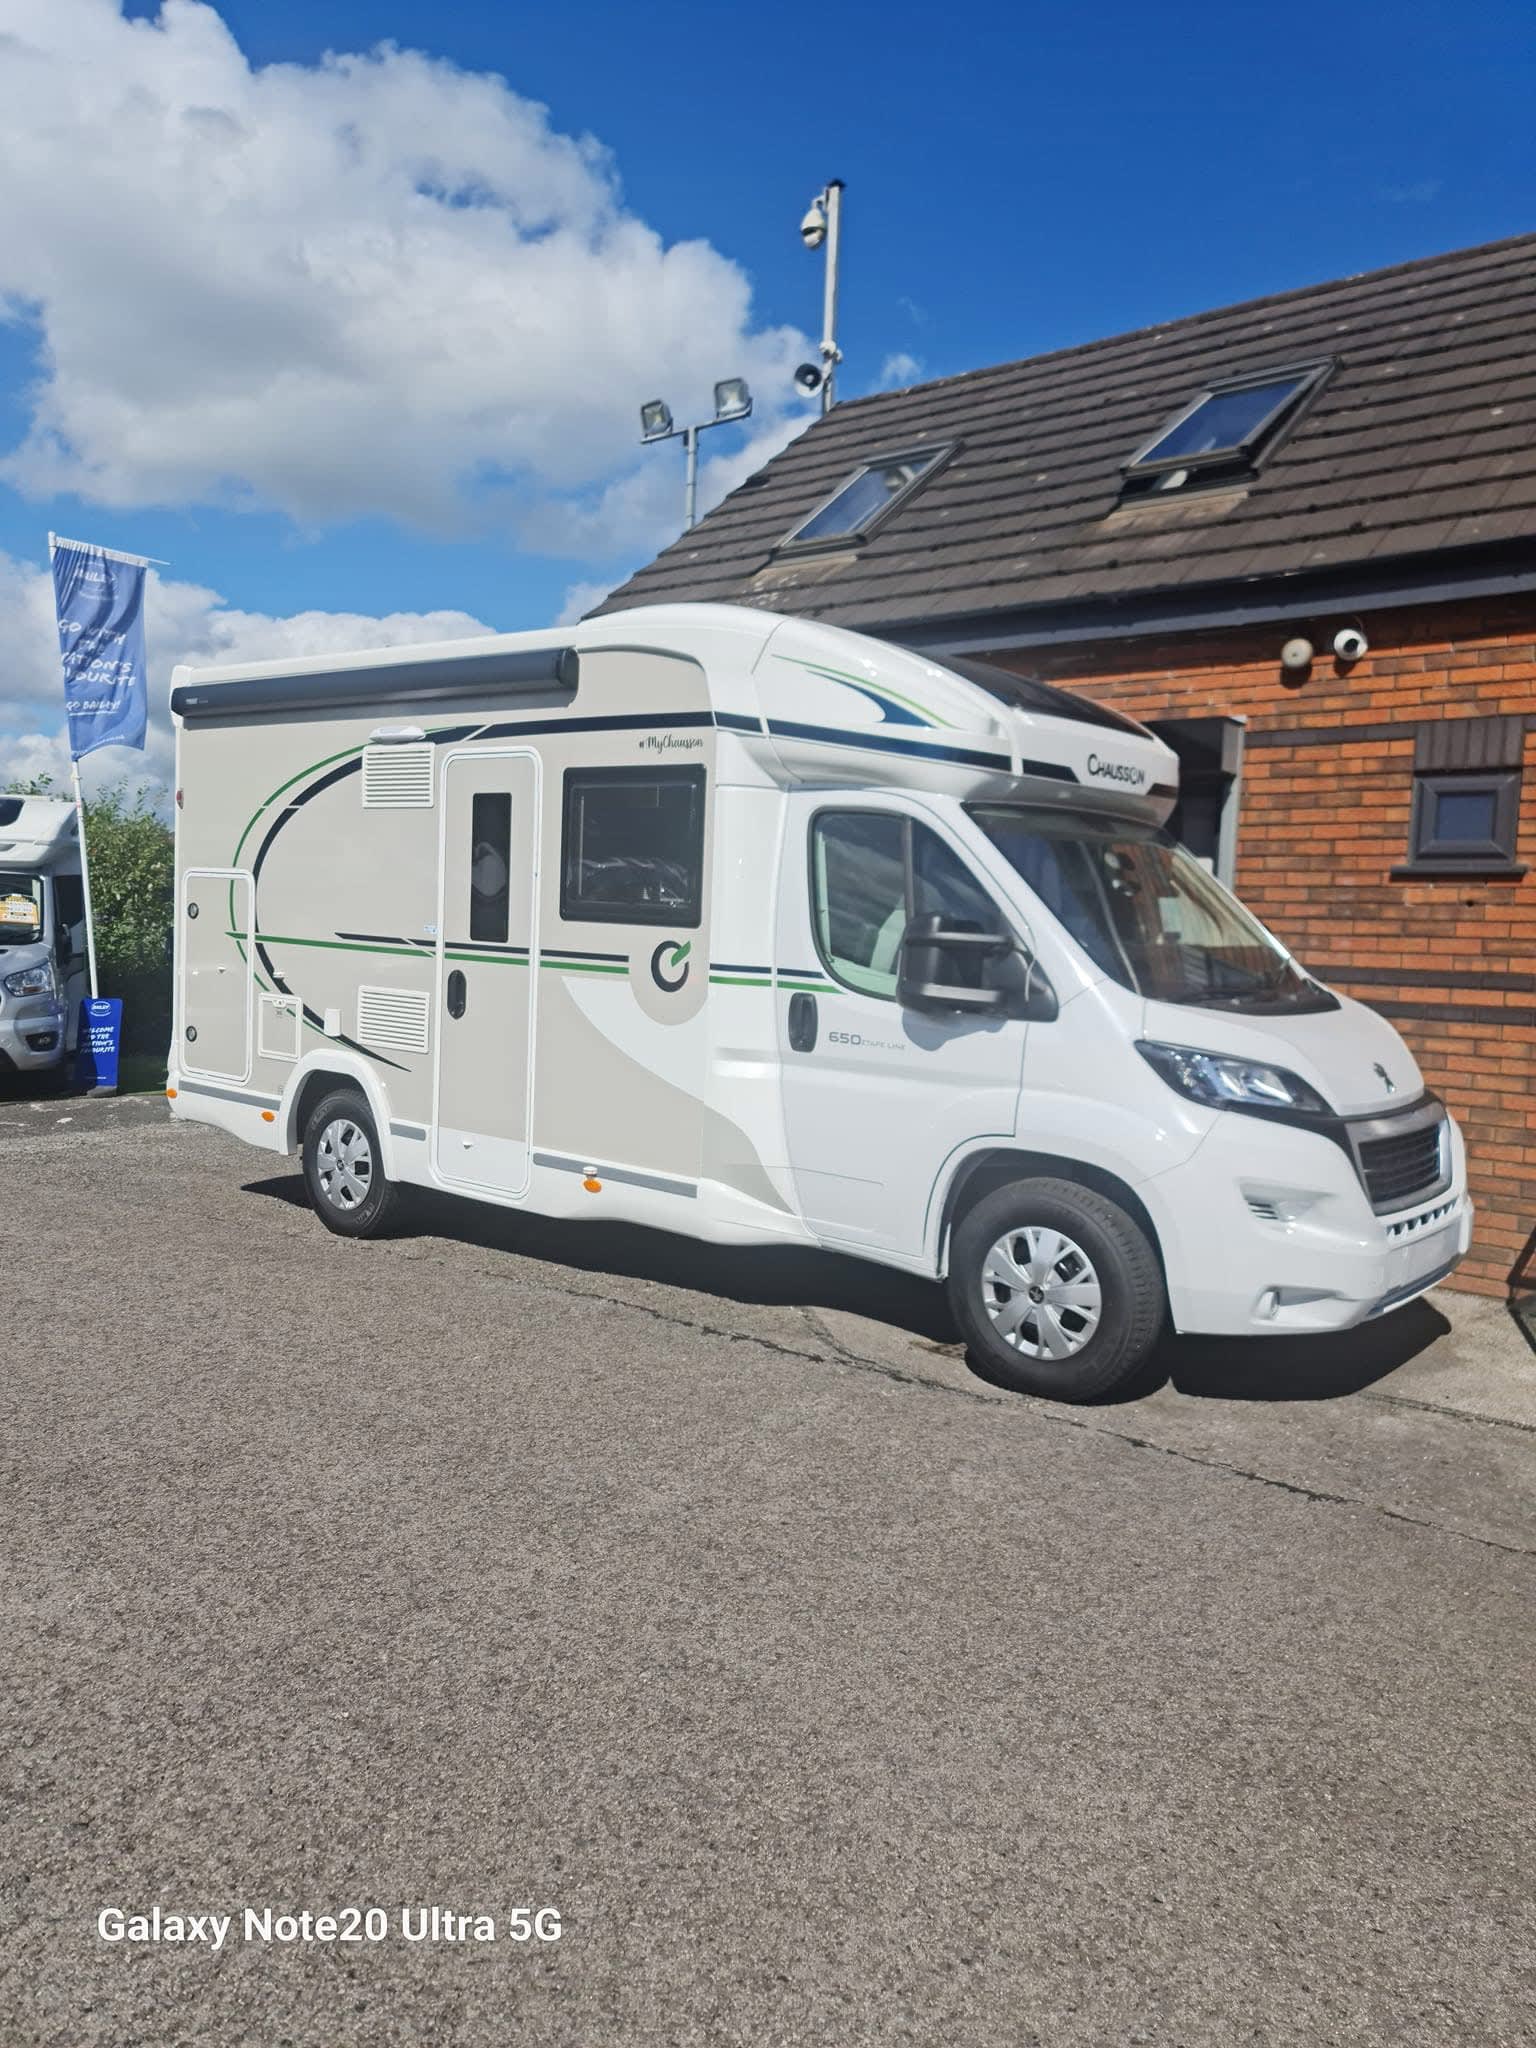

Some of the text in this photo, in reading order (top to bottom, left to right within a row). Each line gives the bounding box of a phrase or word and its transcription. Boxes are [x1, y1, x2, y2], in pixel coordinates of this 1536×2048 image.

[58, 618, 82, 633] GO
[66, 700, 81, 712] GO
[638, 733, 704, 754] #MyChausson
[828, 1031, 862, 1046] 650
